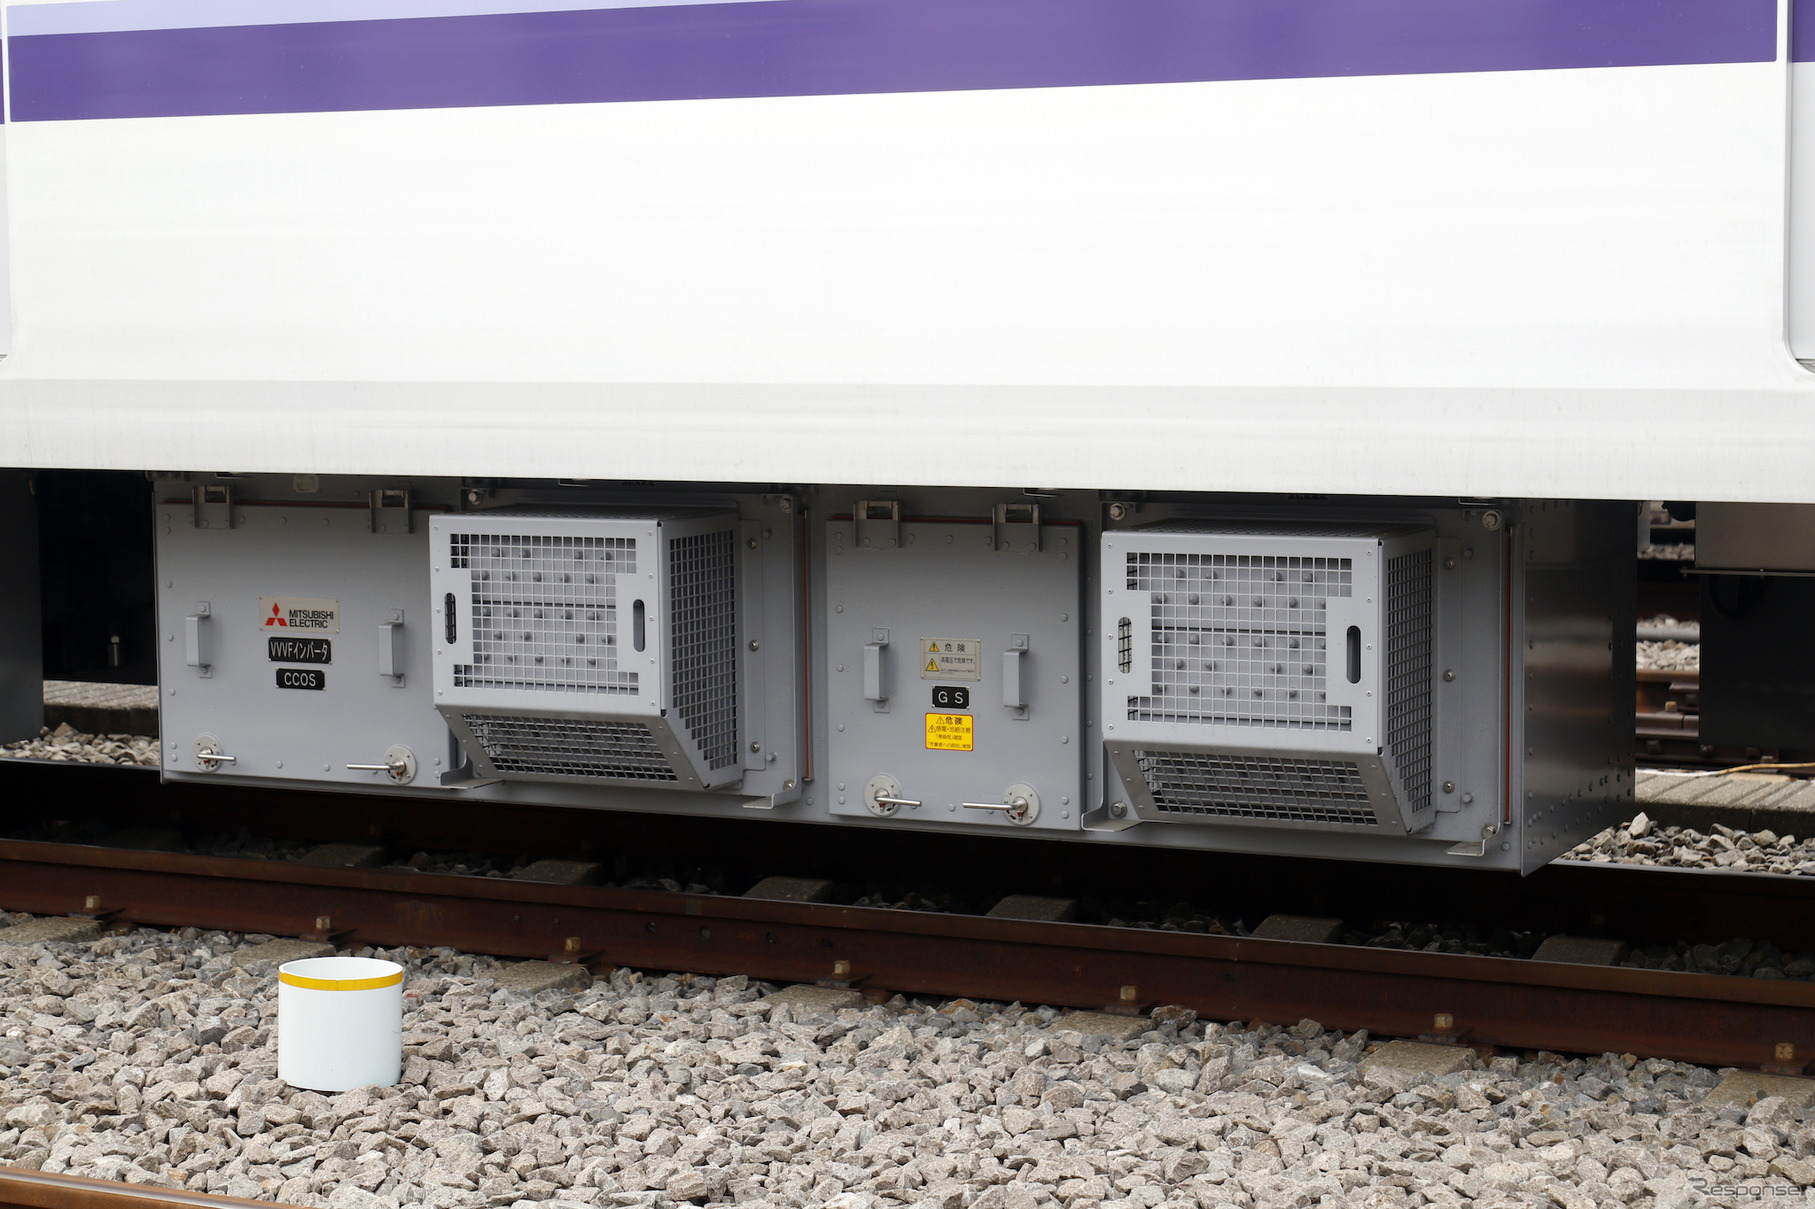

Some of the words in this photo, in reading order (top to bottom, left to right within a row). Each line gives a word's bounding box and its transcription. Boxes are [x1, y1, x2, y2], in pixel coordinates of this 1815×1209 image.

[289, 609, 334, 620] MITSUBISHI
[289, 619, 328, 629] ELECTRIC
[270, 641, 328, 661] VVVFインバータ
[284, 672, 316, 687] CCOS
